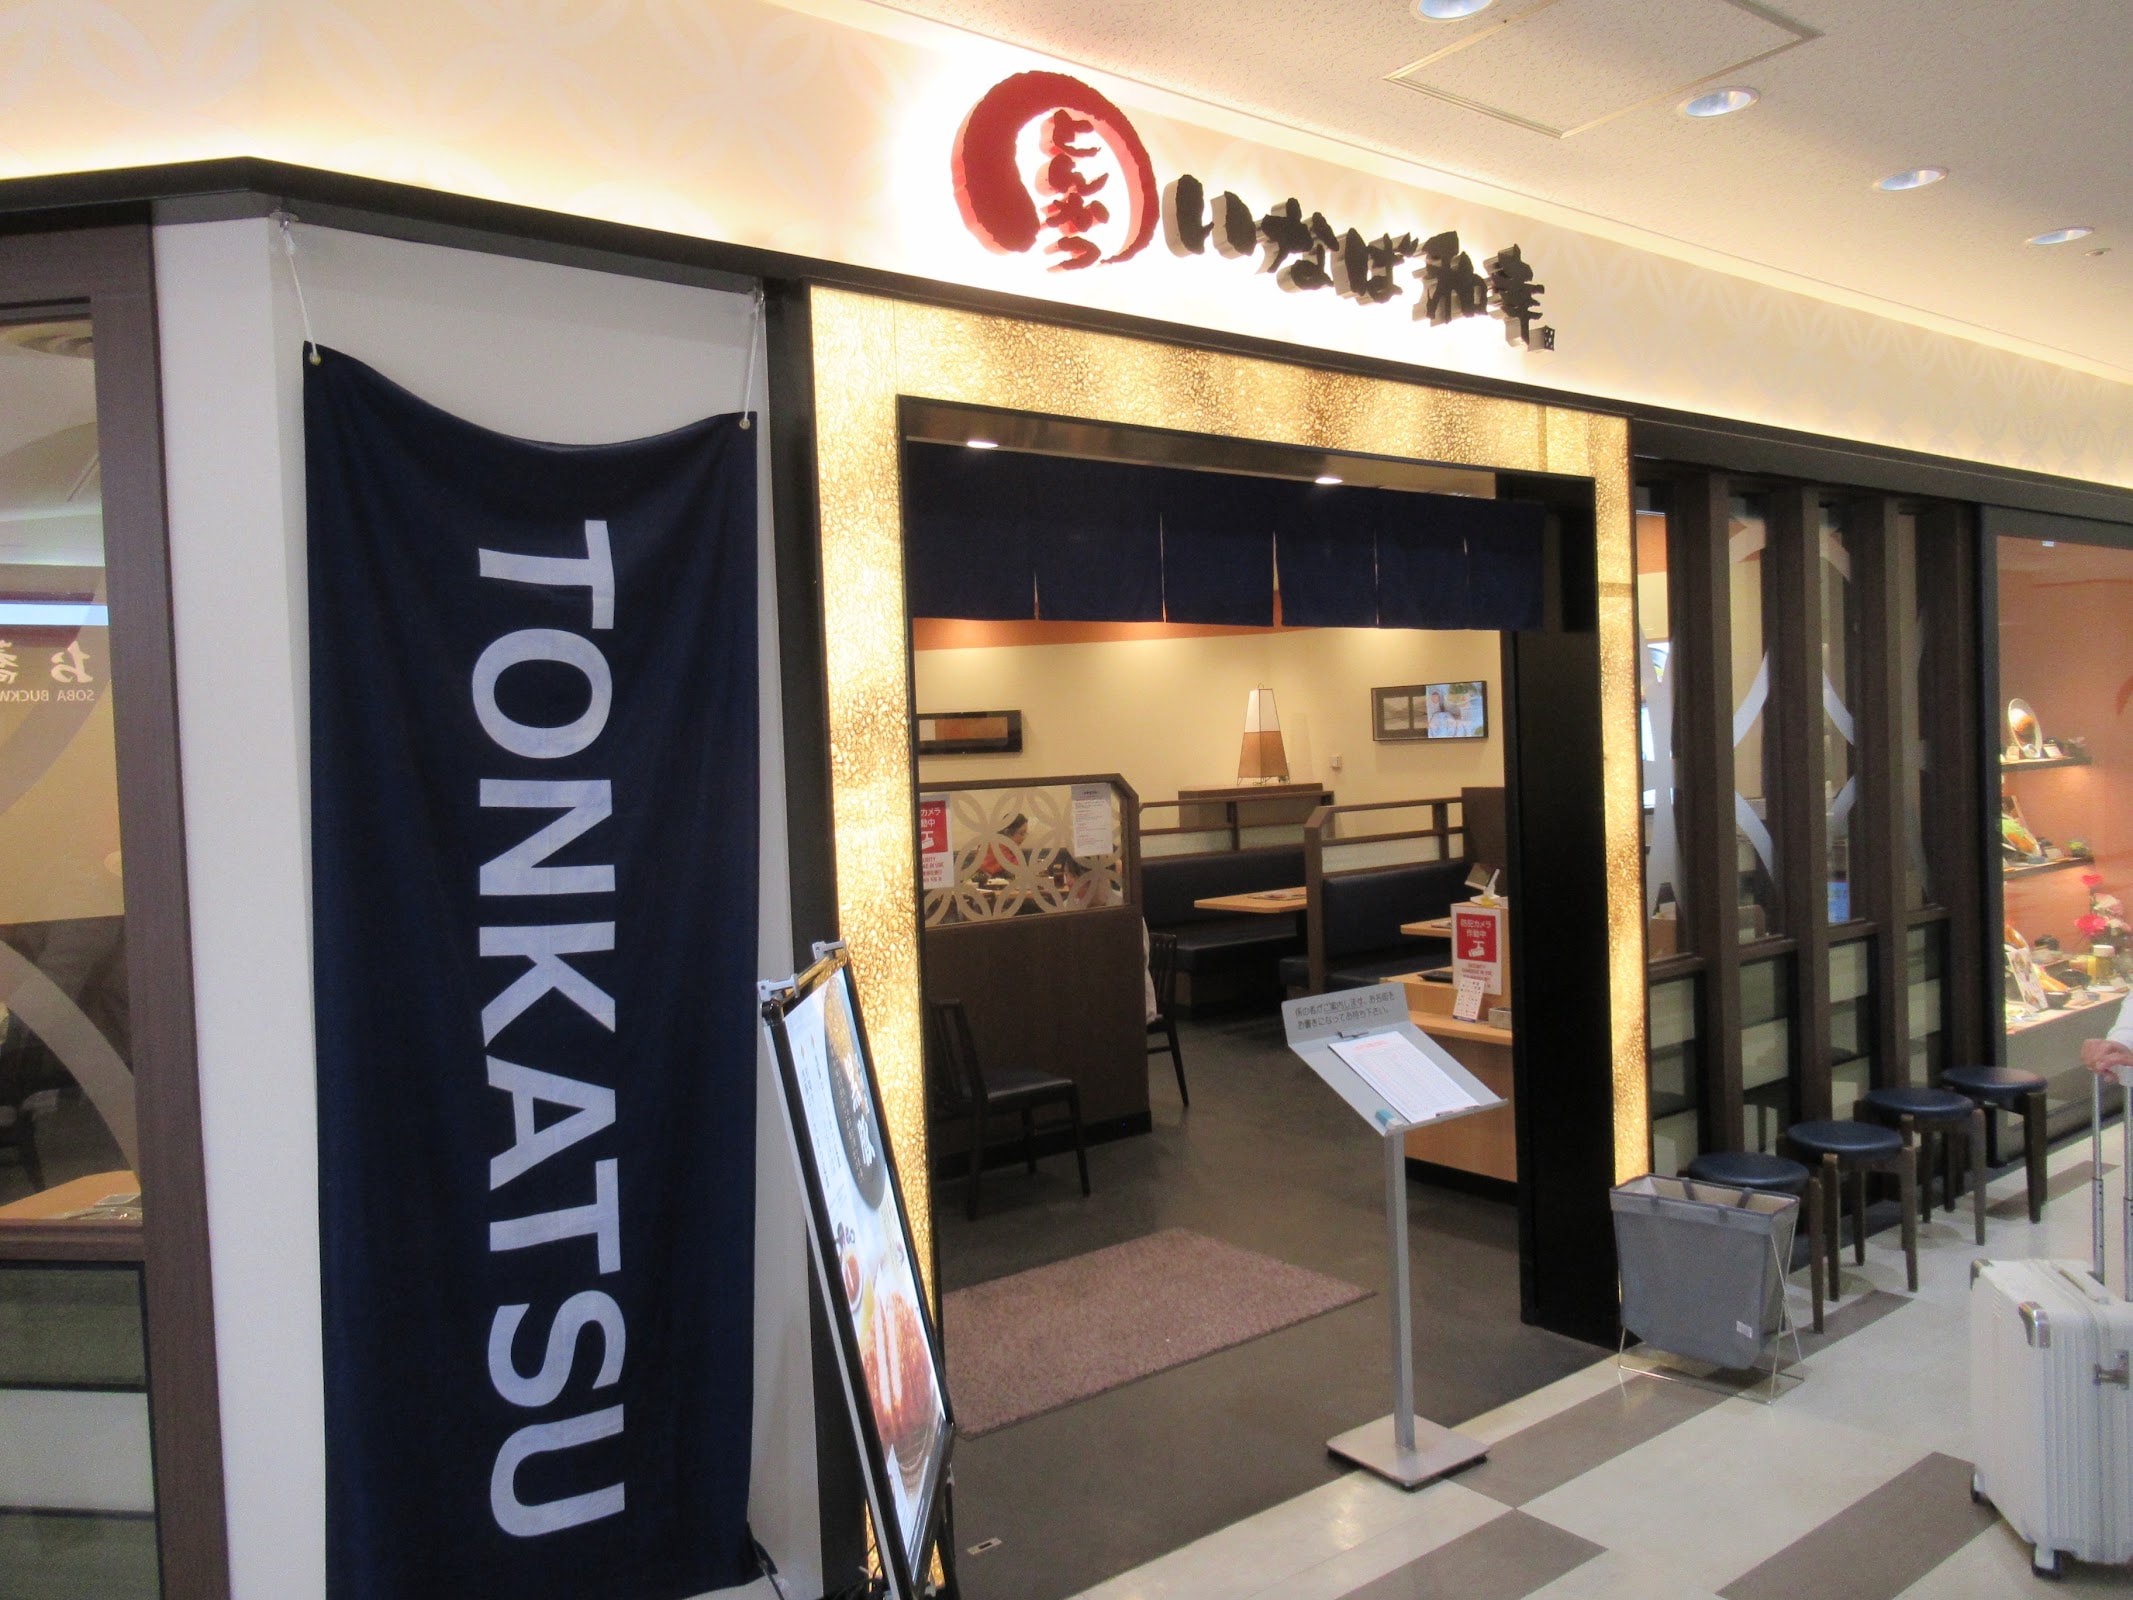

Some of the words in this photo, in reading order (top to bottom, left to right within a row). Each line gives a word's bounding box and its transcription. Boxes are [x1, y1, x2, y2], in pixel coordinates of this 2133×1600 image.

[1036, 108, 1110, 272] とんかつ
[1163, 174, 1545, 350] いなば和幸
[470, 518, 627, 1539] TONKATSU
